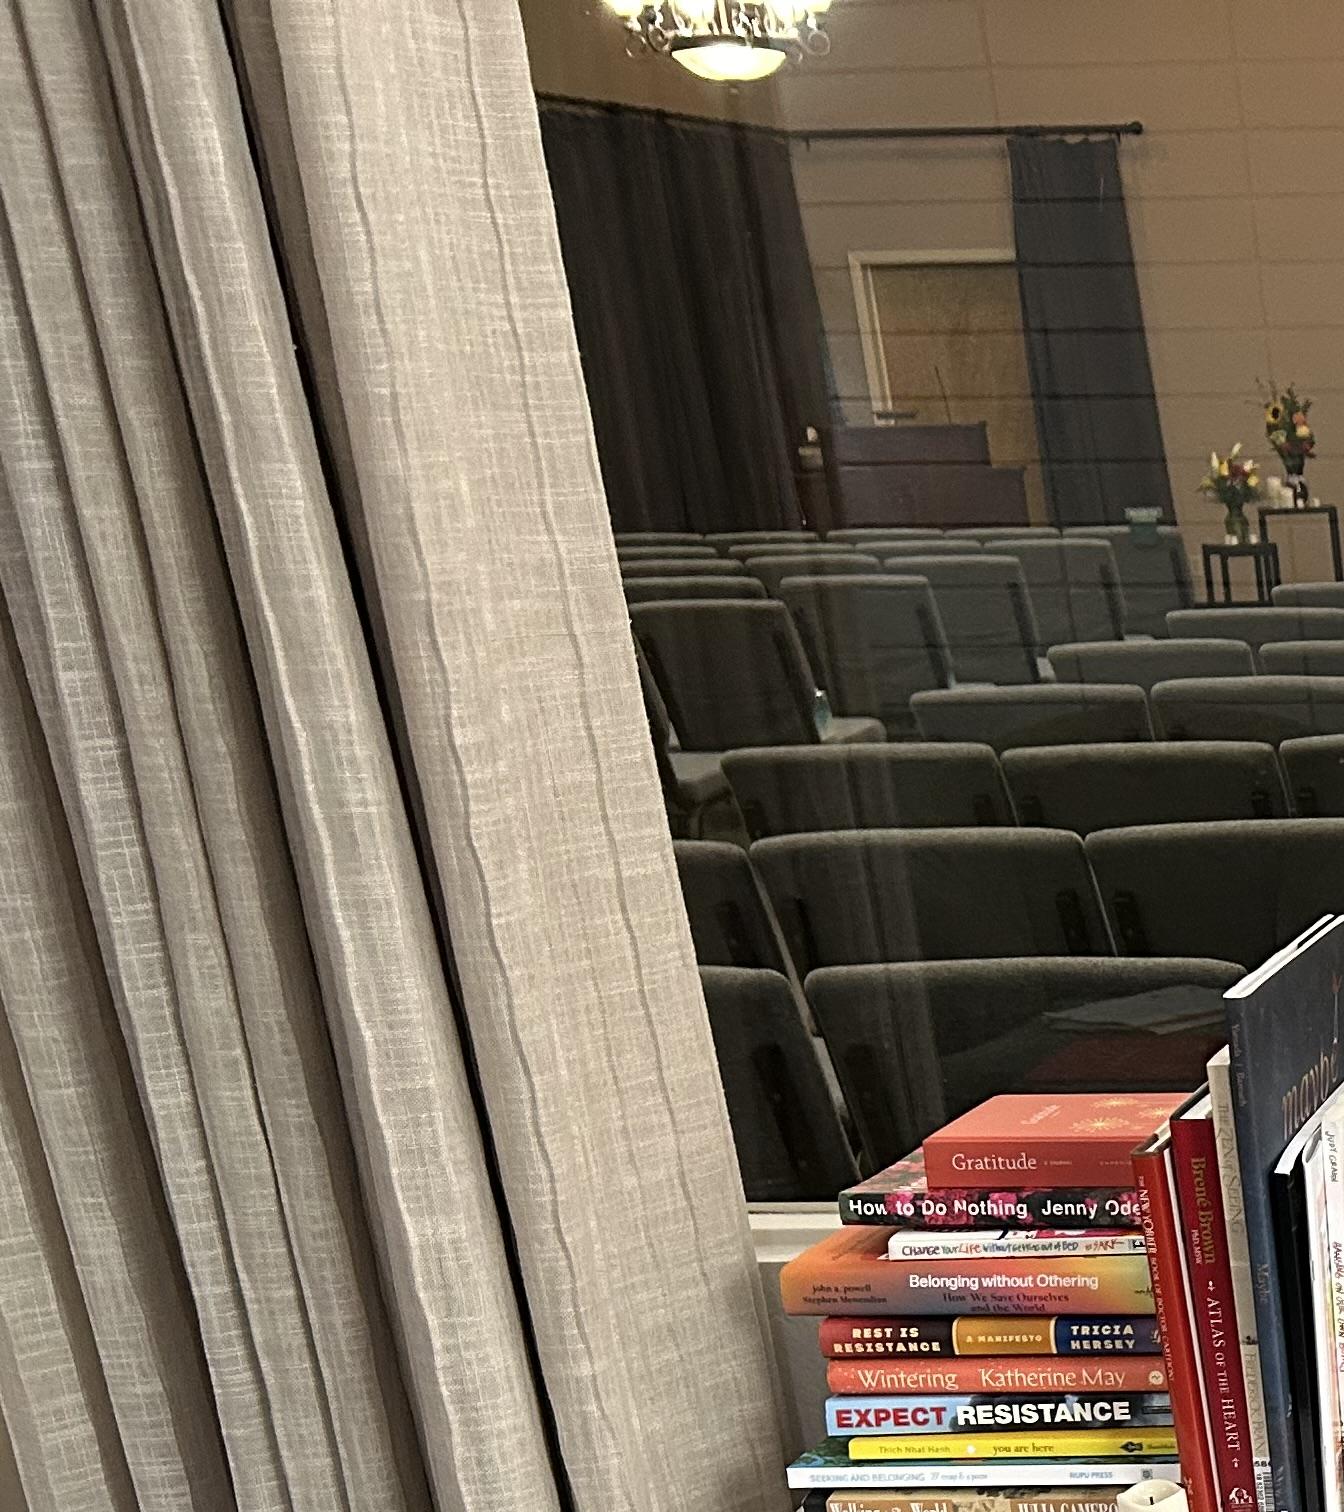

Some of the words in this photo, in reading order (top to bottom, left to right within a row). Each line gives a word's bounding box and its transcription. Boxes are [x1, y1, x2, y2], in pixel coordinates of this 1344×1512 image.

[952, 1153, 1038, 1172] Gratitude
[1191, 1157, 1211, 1208] Brené
[848, 1199, 888, 1217] How
[896, 1200, 915, 1216] to
[921, 1199, 948, 1215] Do
[954, 1199, 1029, 1219] Nothing
[1041, 1199, 1098, 1219] Jenny
[1105, 1200, 1142, 1216] Ode
[1199, 1210, 1218, 1264] Brown
[908, 1274, 979, 1291] Belonging
[981, 1274, 1035, 1288] without
[1036, 1273, 1100, 1291] Othering
[1070, 1324, 1135, 1337] TRICIA
[1206, 1297, 1226, 1348] ATLAS
[851, 1327, 896, 1339] REST
[899, 1326, 919, 1339] IS
[833, 1340, 941, 1354] RESISTANCE
[1070, 1338, 1136, 1351] HERSEY
[1216, 1351, 1227, 1368] OF
[857, 1368, 959, 1392] Wintering
[978, 1367, 1077, 1388] Katherine
[1080, 1368, 1126, 1390] May
[1217, 1370, 1230, 1394] THE
[834, 1405, 949, 1430] EXPECT
[957, 1401, 1131, 1428] RESISTANCE
[1221, 1397, 1241, 1451] HEART
[992, 1445, 1007, 1456] you
[1009, 1445, 1028, 1454] are
[1030, 1442, 1054, 1454] here
